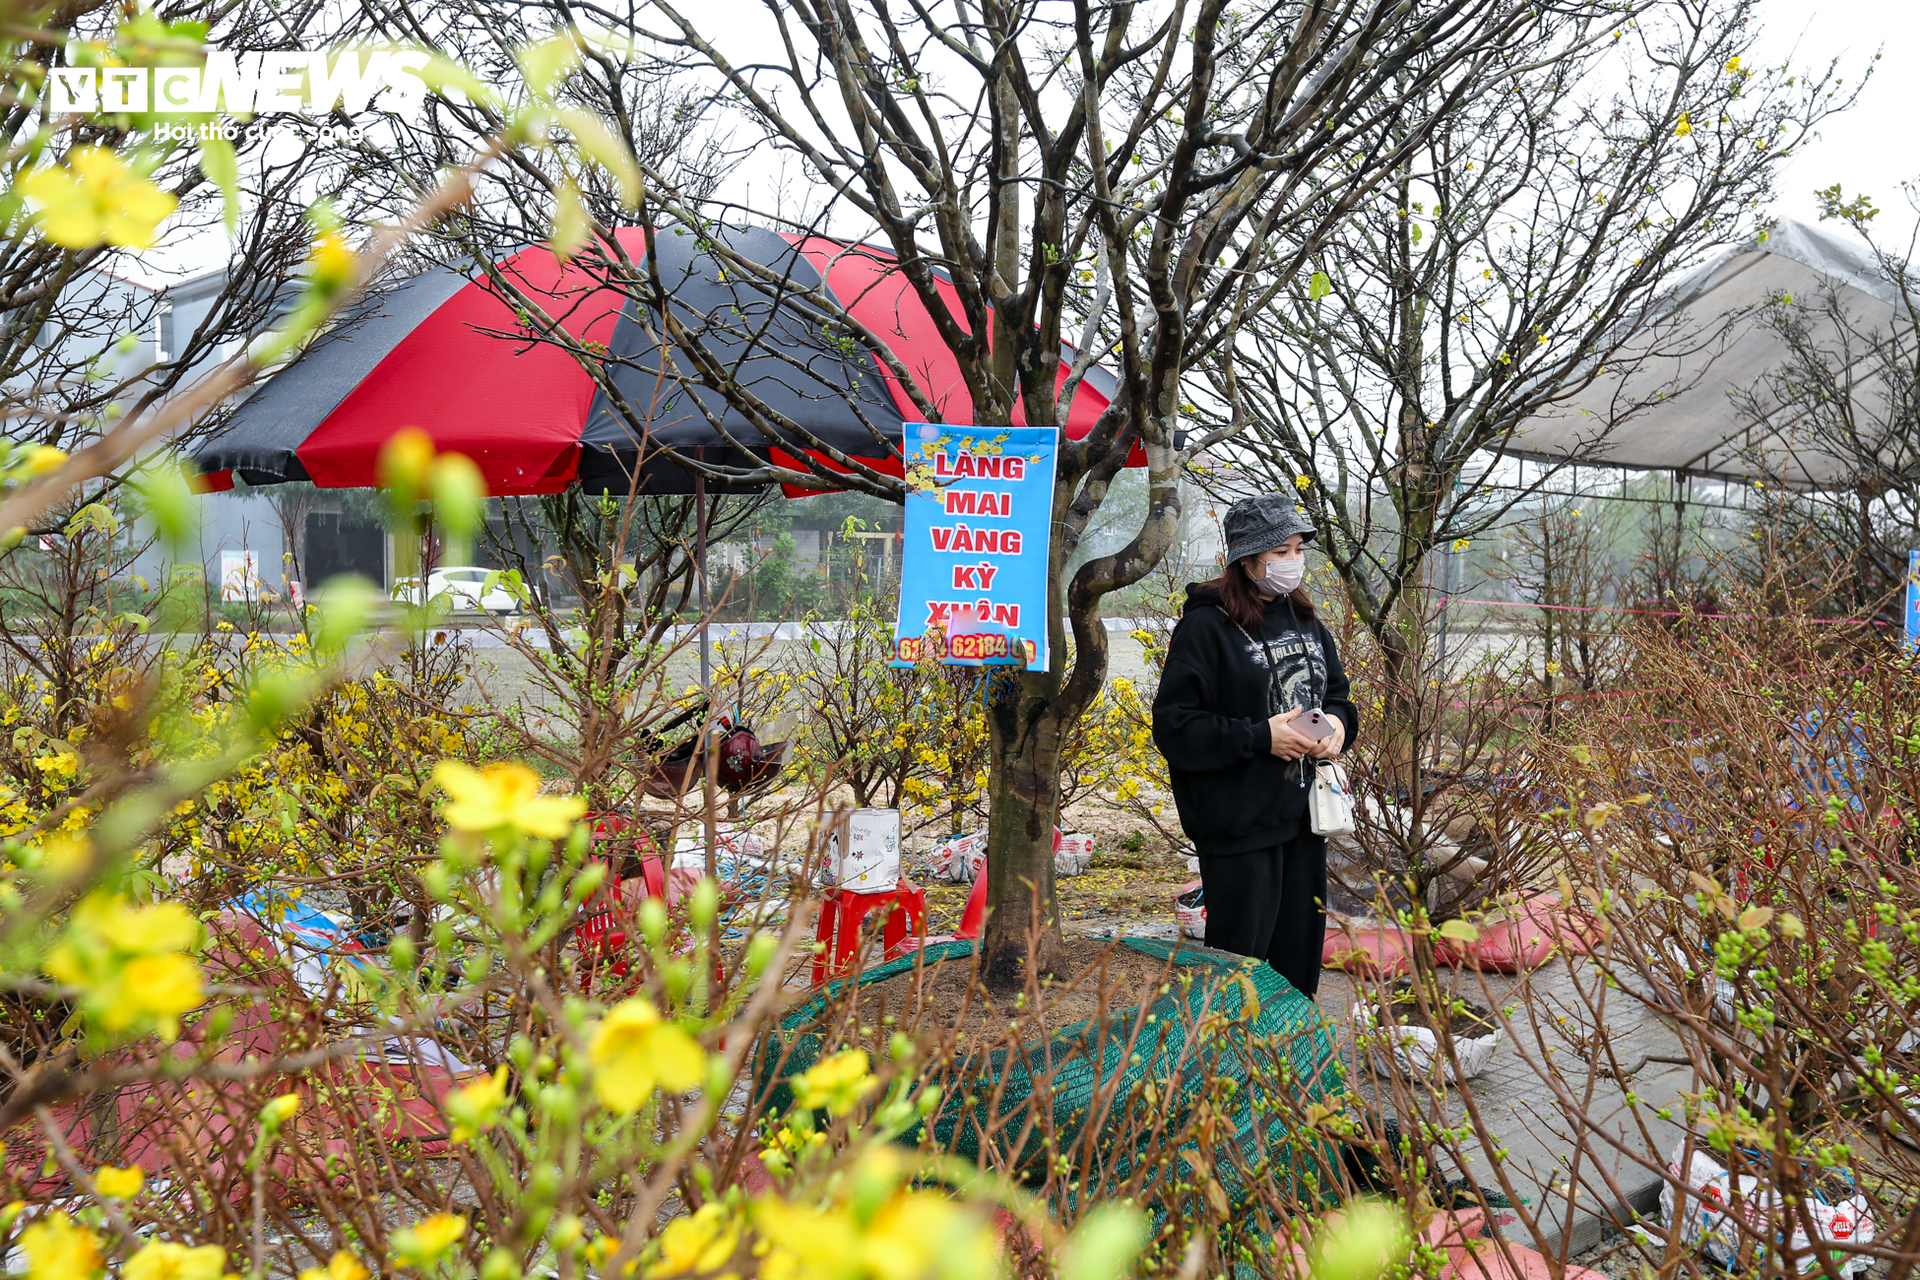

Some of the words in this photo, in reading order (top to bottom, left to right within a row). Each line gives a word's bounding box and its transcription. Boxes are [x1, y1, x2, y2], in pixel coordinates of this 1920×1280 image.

[935, 451, 1024, 480] LÀNG
[945, 490, 1011, 517] MAI
[931, 524, 1022, 553] VÀNG
[953, 562, 997, 589] KỲ
